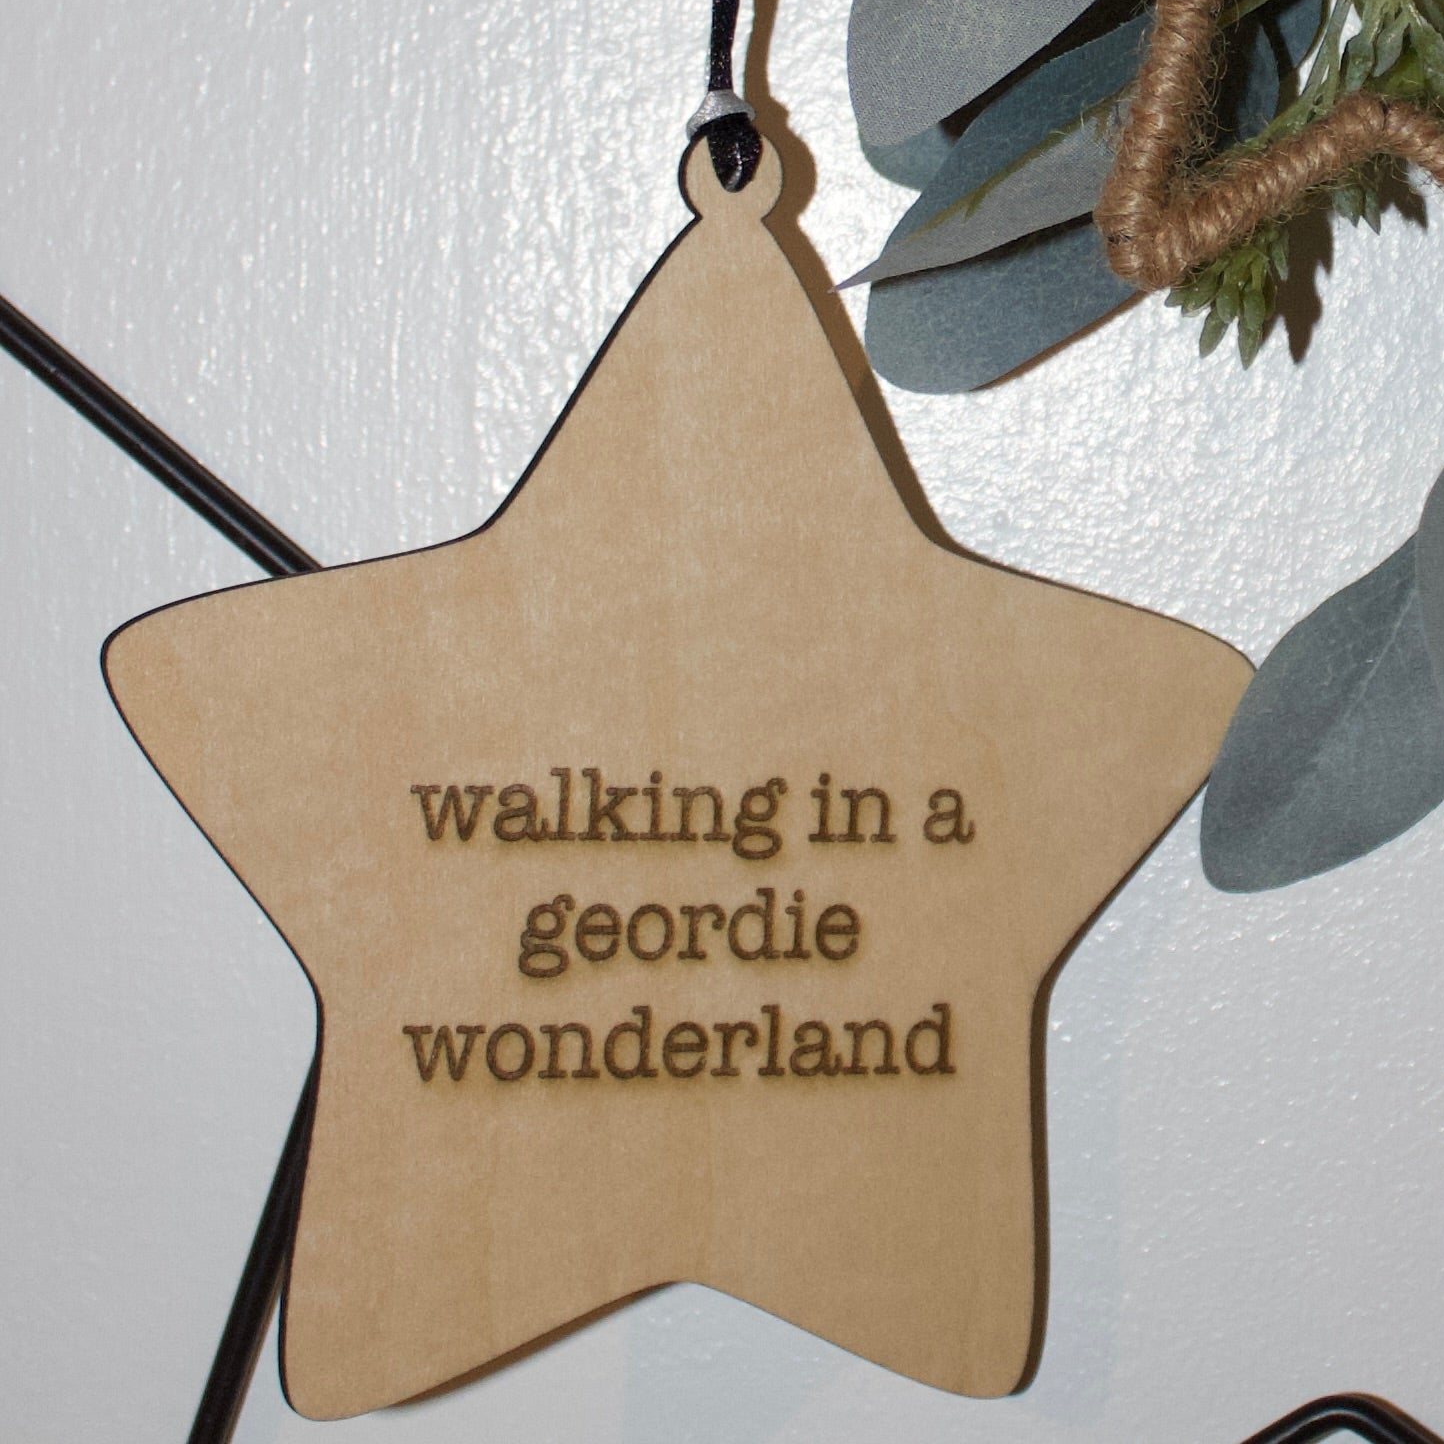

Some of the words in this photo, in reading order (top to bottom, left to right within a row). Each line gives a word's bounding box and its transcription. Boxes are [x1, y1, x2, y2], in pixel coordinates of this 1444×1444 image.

[409, 767, 788, 861] walking
[807, 772, 897, 845] in
[923, 788, 976, 846] a
[517, 887, 862, 980] geordie
[401, 1002, 958, 1084] wonderland
